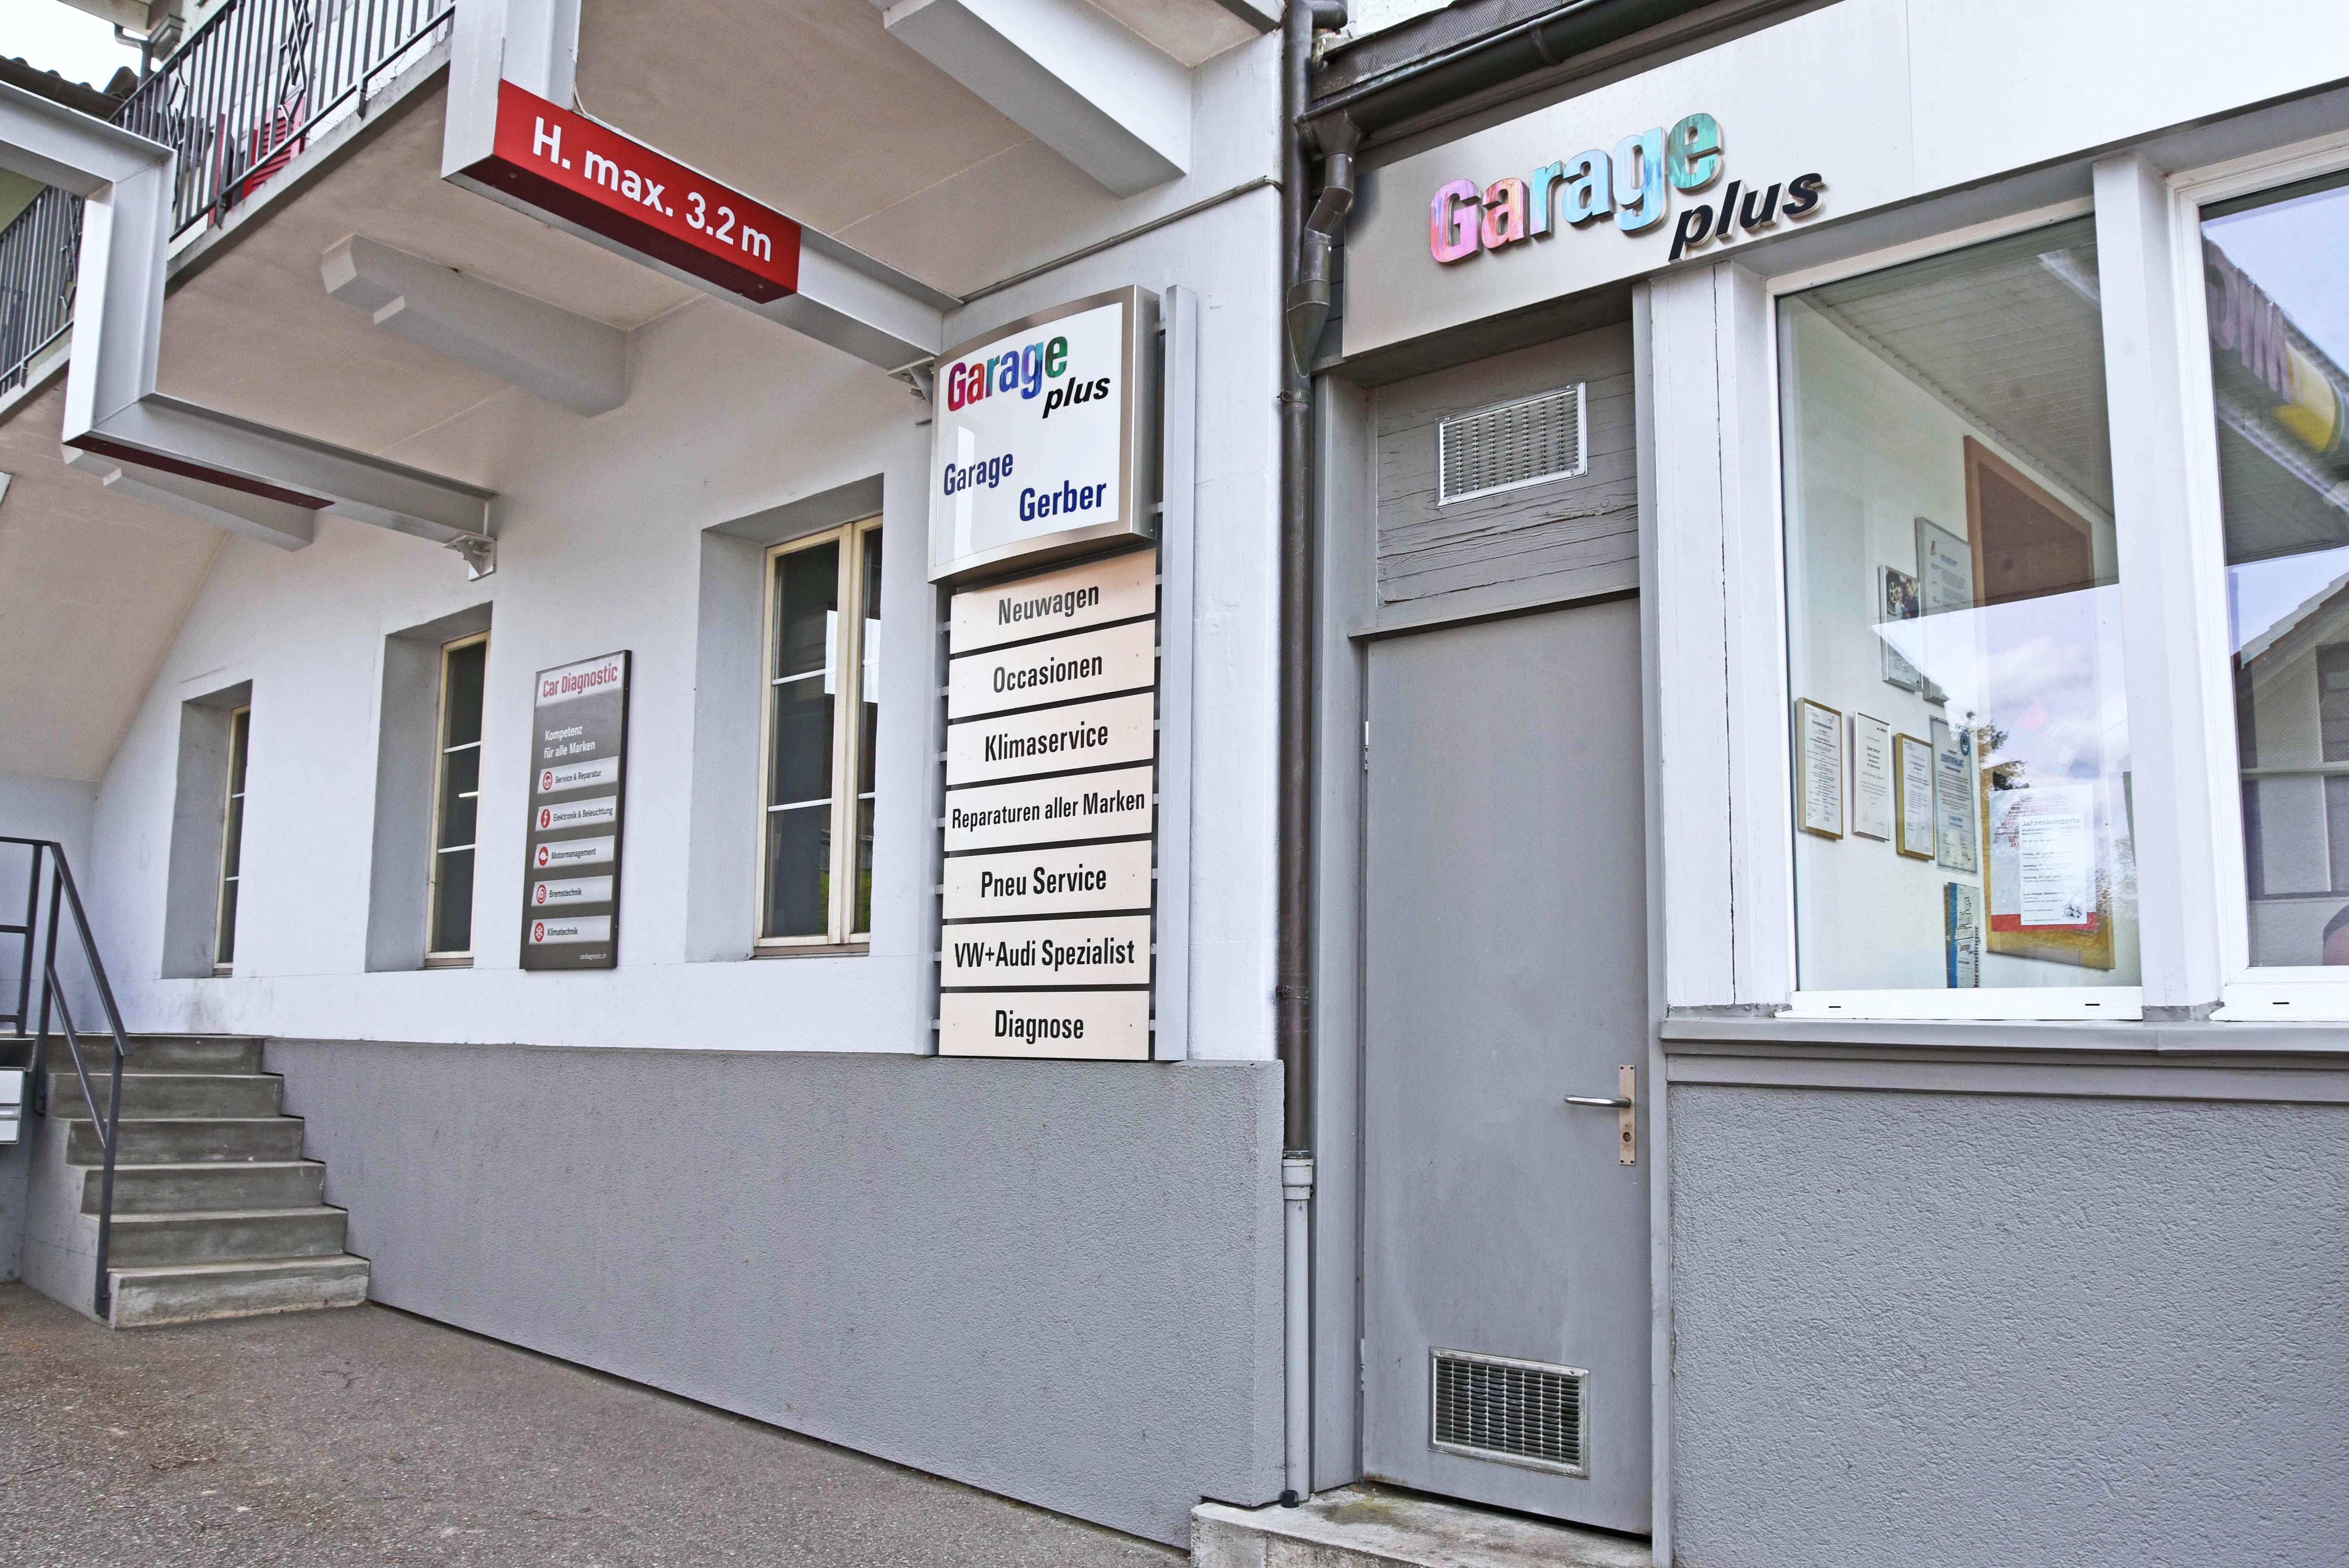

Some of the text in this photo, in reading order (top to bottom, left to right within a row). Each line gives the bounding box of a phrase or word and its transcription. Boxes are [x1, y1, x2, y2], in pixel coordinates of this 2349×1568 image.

[533, 116, 771, 262] H. max. 3.2 m
[1429, 112, 1723, 266] Garage
[1668, 173, 1825, 264] plus
[948, 336, 1068, 412] Garage
[1042, 377, 1110, 419] plus
[944, 453, 1013, 495] Garage
[1019, 480, 1107, 522] Gerber
[998, 586, 1099, 625] Neuwagen
[543, 663, 618, 697] Car Diagnostic
[993, 655, 1102, 693] Occasionen
[544, 741, 595, 759] für alle Marken
[545, 726, 582, 741] Kompetenz
[985, 721, 1108, 762] Klimaservice
[578, 770, 602, 781] Reparatur
[554, 811, 577, 821] Elektronik
[583, 807, 613, 818] Beleuchtung
[952, 790, 1145, 832] Reparaturen aller Marken
[551, 848, 596, 859] Motormanagement
[549, 887, 582, 898] Bremstechnik
[981, 864, 1107, 898] Pneu Service
[547, 927, 578, 936] Klimatechnik
[955, 937, 1135, 972] VW+Audi Spezialist
[995, 1010, 1084, 1044] Diagnose
